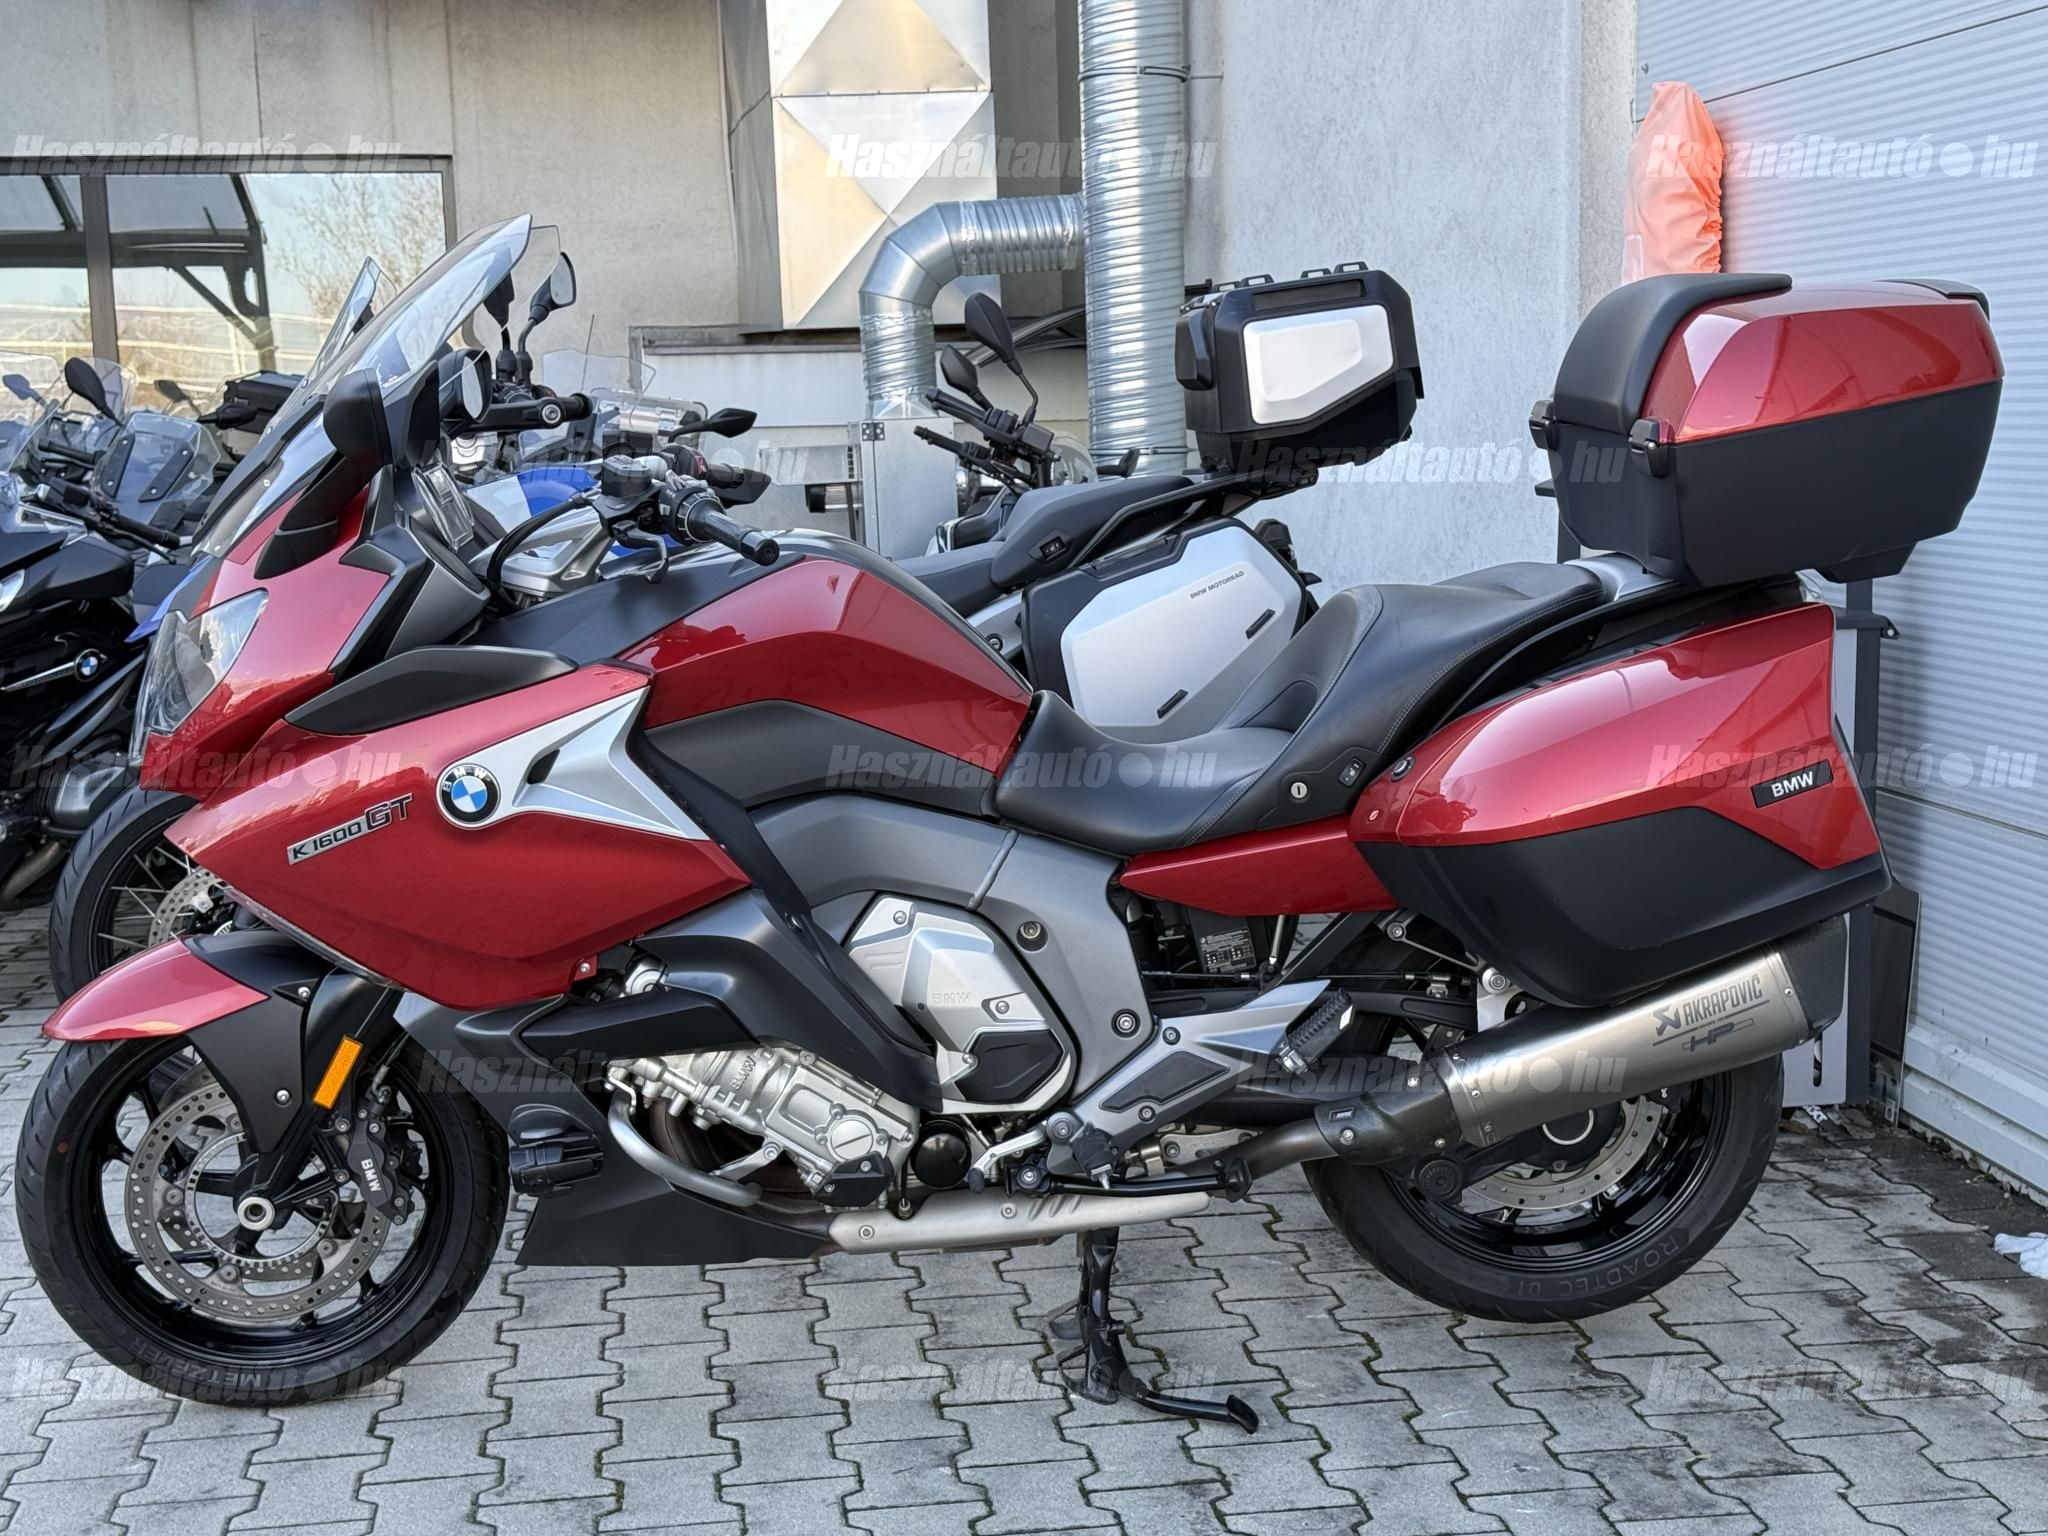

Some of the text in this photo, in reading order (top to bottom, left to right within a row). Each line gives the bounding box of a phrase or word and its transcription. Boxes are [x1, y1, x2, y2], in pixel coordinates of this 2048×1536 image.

[1190, 570, 1245, 599] BMW MOTORRAD
[1771, 771, 1813, 798] BMW
[364, 792, 413, 831] GT
[932, 991, 971, 1005] BMW
[730, 1055, 757, 1092] BMW
[361, 1158, 382, 1192] BMW
[1559, 1234, 1680, 1290] ROADTEC
